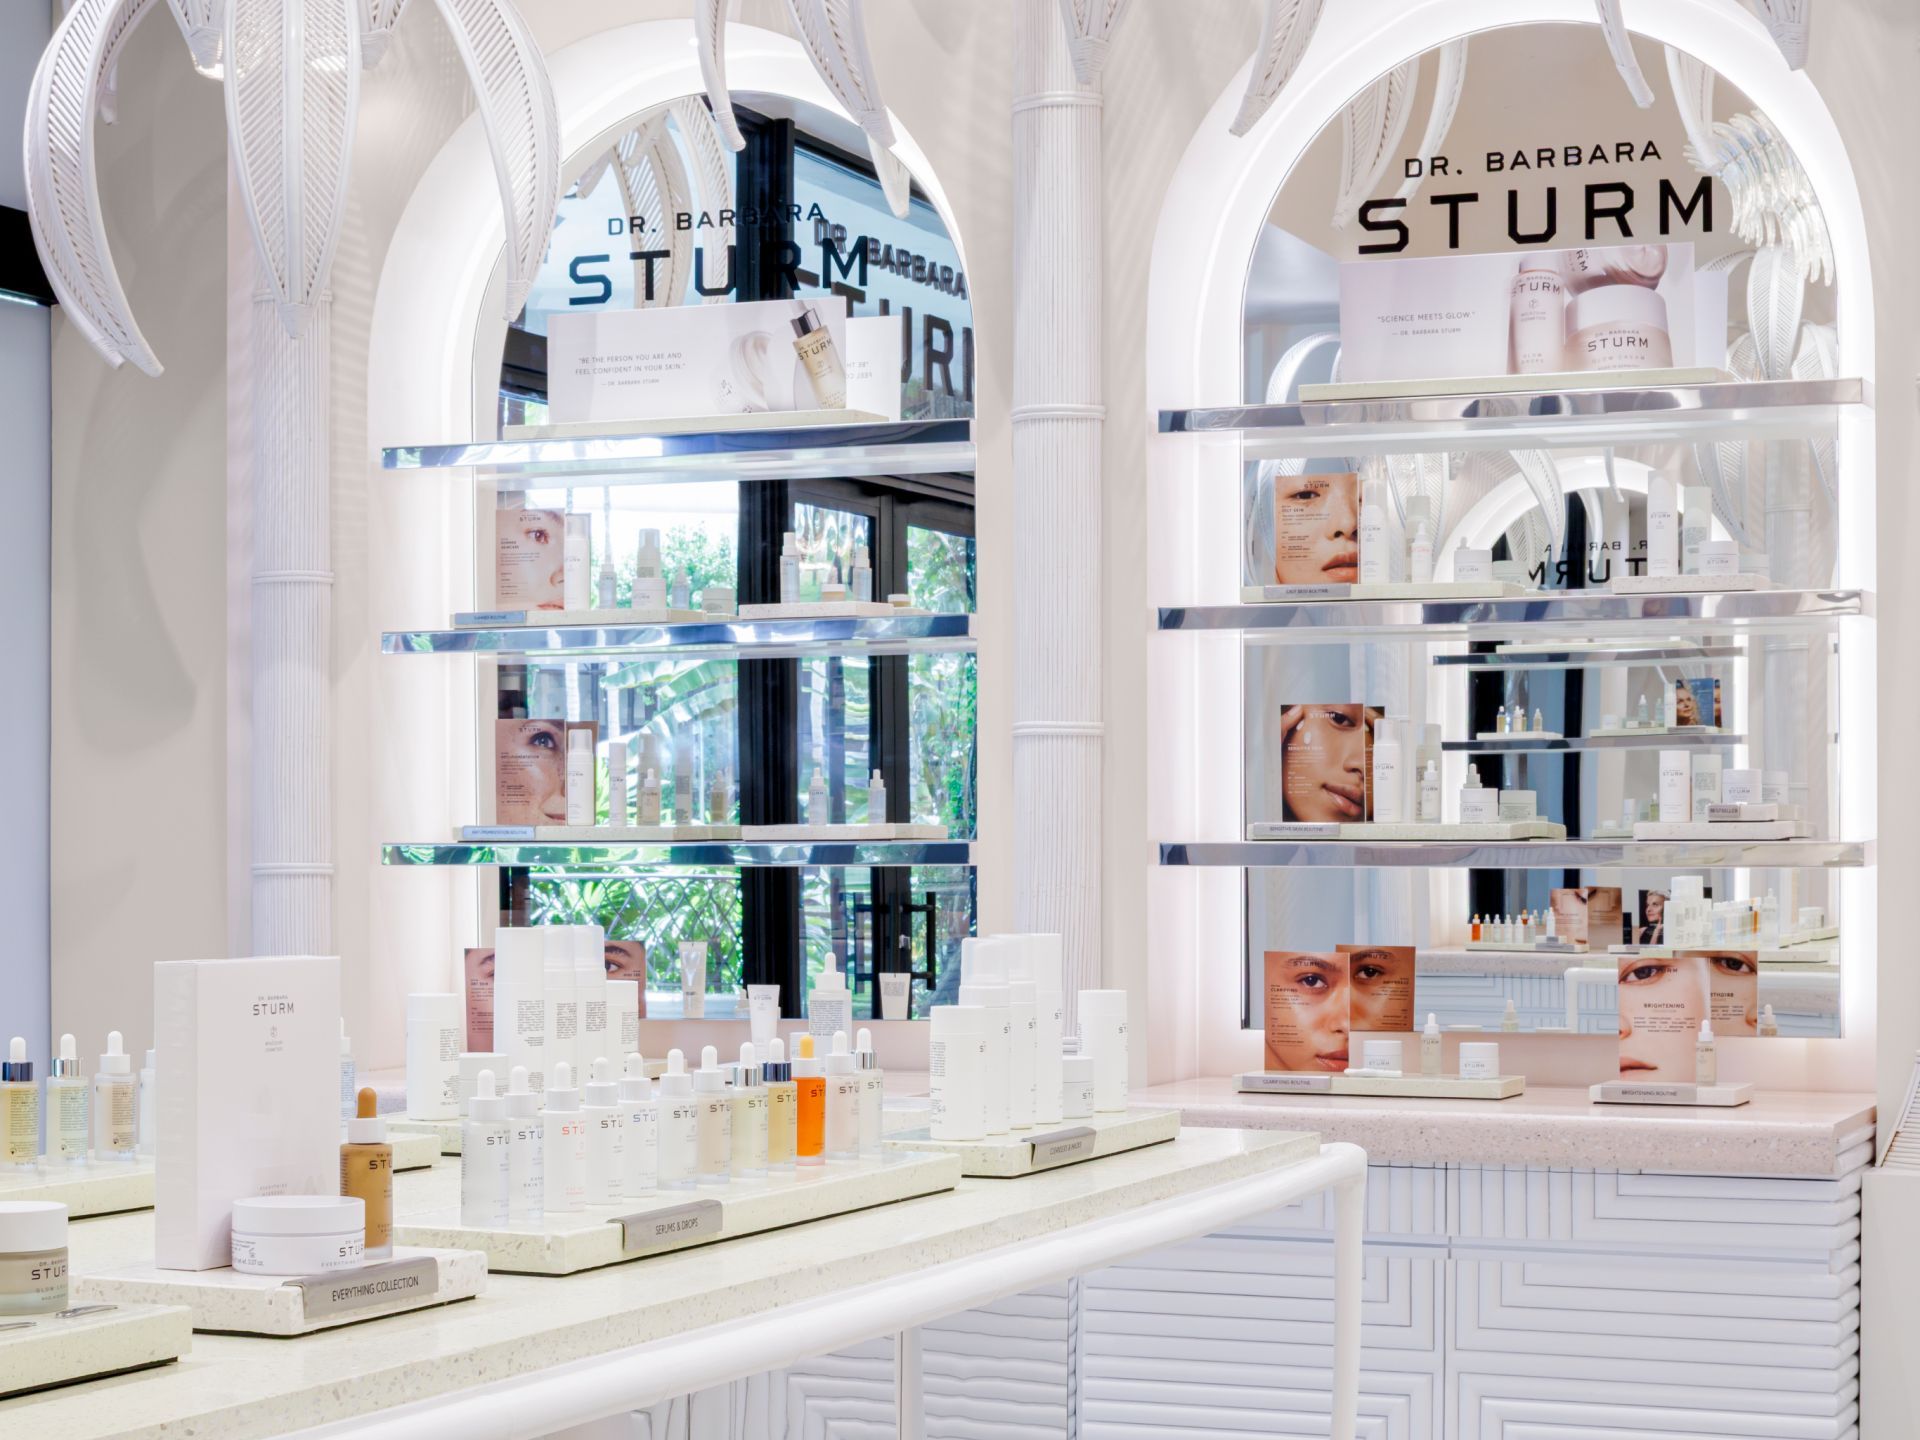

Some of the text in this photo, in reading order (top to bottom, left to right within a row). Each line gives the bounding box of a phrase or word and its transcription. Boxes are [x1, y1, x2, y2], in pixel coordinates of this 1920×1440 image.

[1405, 140, 1662, 179] DR. BARBARA
[608, 202, 825, 237] DR. BARBARA
[1358, 176, 1713, 255] STURM
[569, 235, 869, 306] STURM
[866, 236, 969, 301] BARBARA
[1417, 312, 1443, 321] MEETS
[798, 338, 833, 361] STURM
[1587, 336, 1649, 353] STURM
[607, 354, 633, 362] PERSON
[636, 353, 650, 361] YOU
[667, 352, 682, 360] AND
[575, 367, 591, 376] FEEL
[593, 365, 632, 375] CONFIDENT
[644, 364, 663, 372] YOUR
[252, 1002, 295, 1016] STURM
[1655, 1089, 1678, 1097] ROUTINE
[655, 1222, 676, 1236] SERUMS
[681, 1217, 699, 1231] DROPS
[332, 1275, 419, 1302] EVERYTHING COLLECTION
